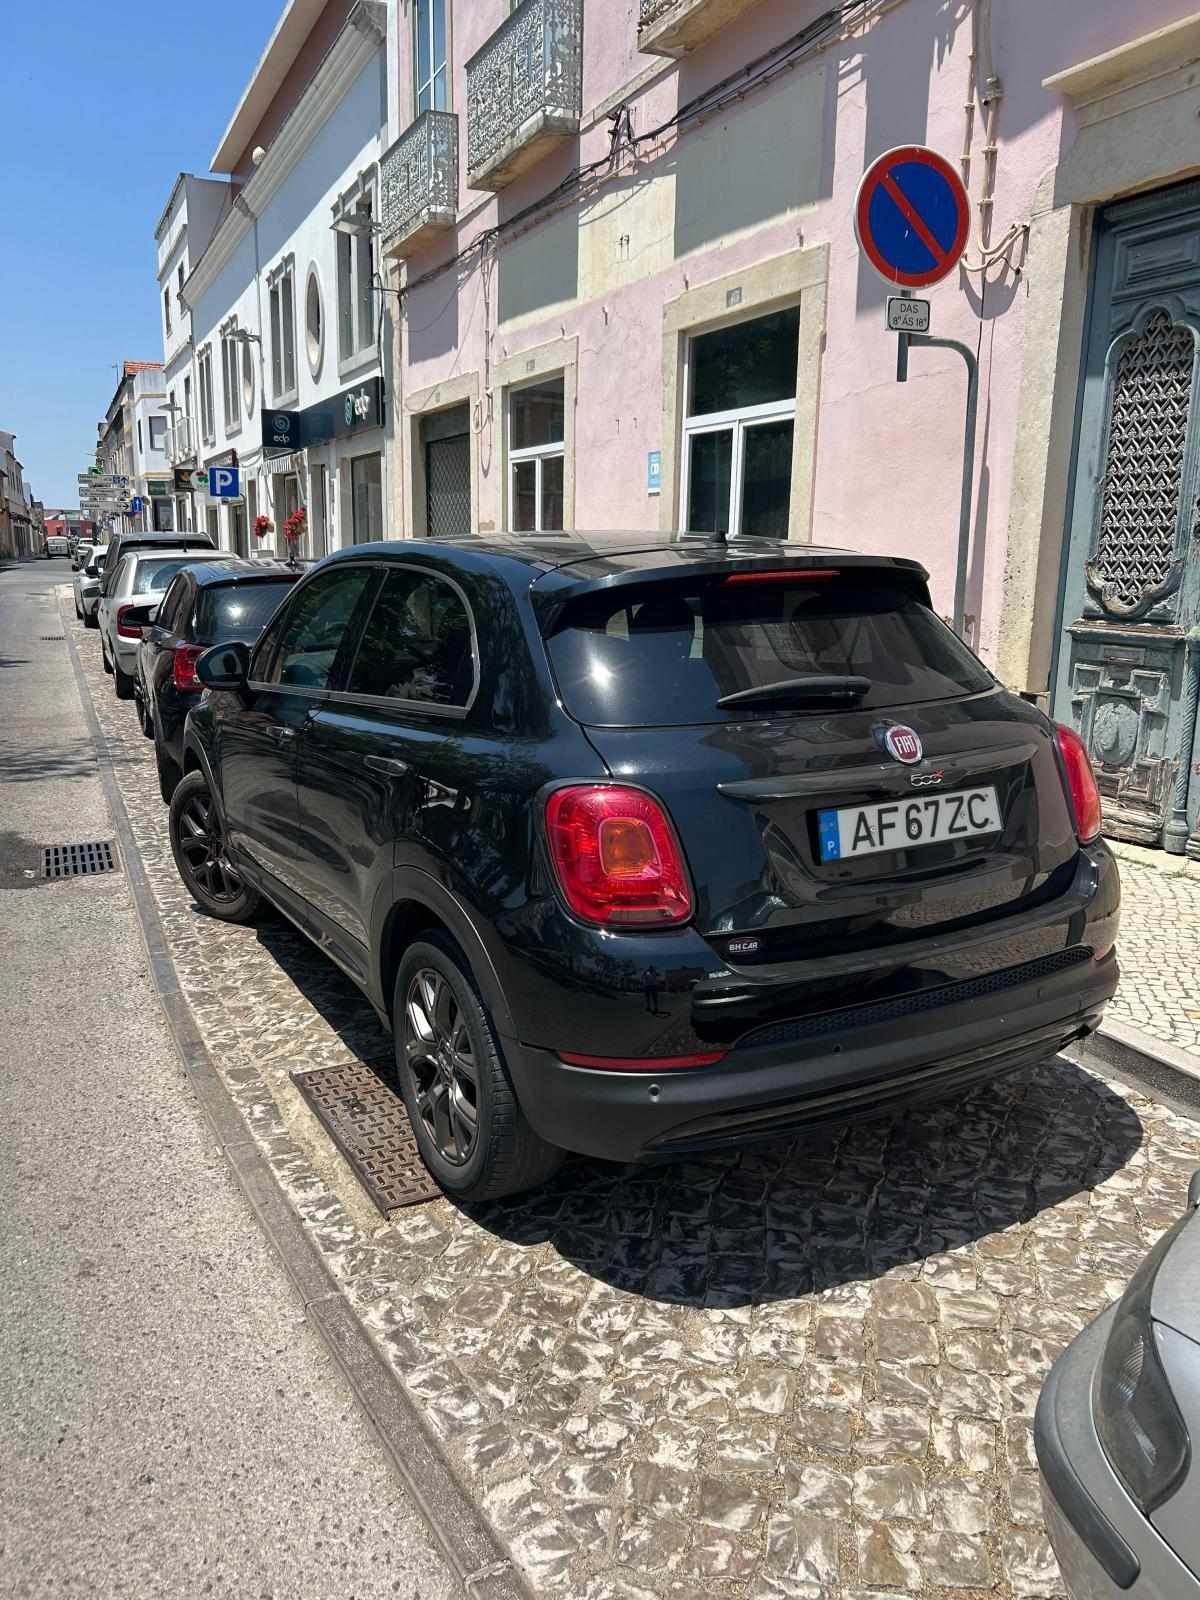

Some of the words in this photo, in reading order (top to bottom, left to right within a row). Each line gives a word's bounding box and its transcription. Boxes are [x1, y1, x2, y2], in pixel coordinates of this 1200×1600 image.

[900, 303, 919, 314] DAS
[354, 387, 370, 421] edp
[272, 433, 290, 445] edp
[215, 469, 233, 495] P
[894, 735, 916, 755] FIAT
[729, 943, 741, 951] BH
[742, 941, 759, 951] CAR
